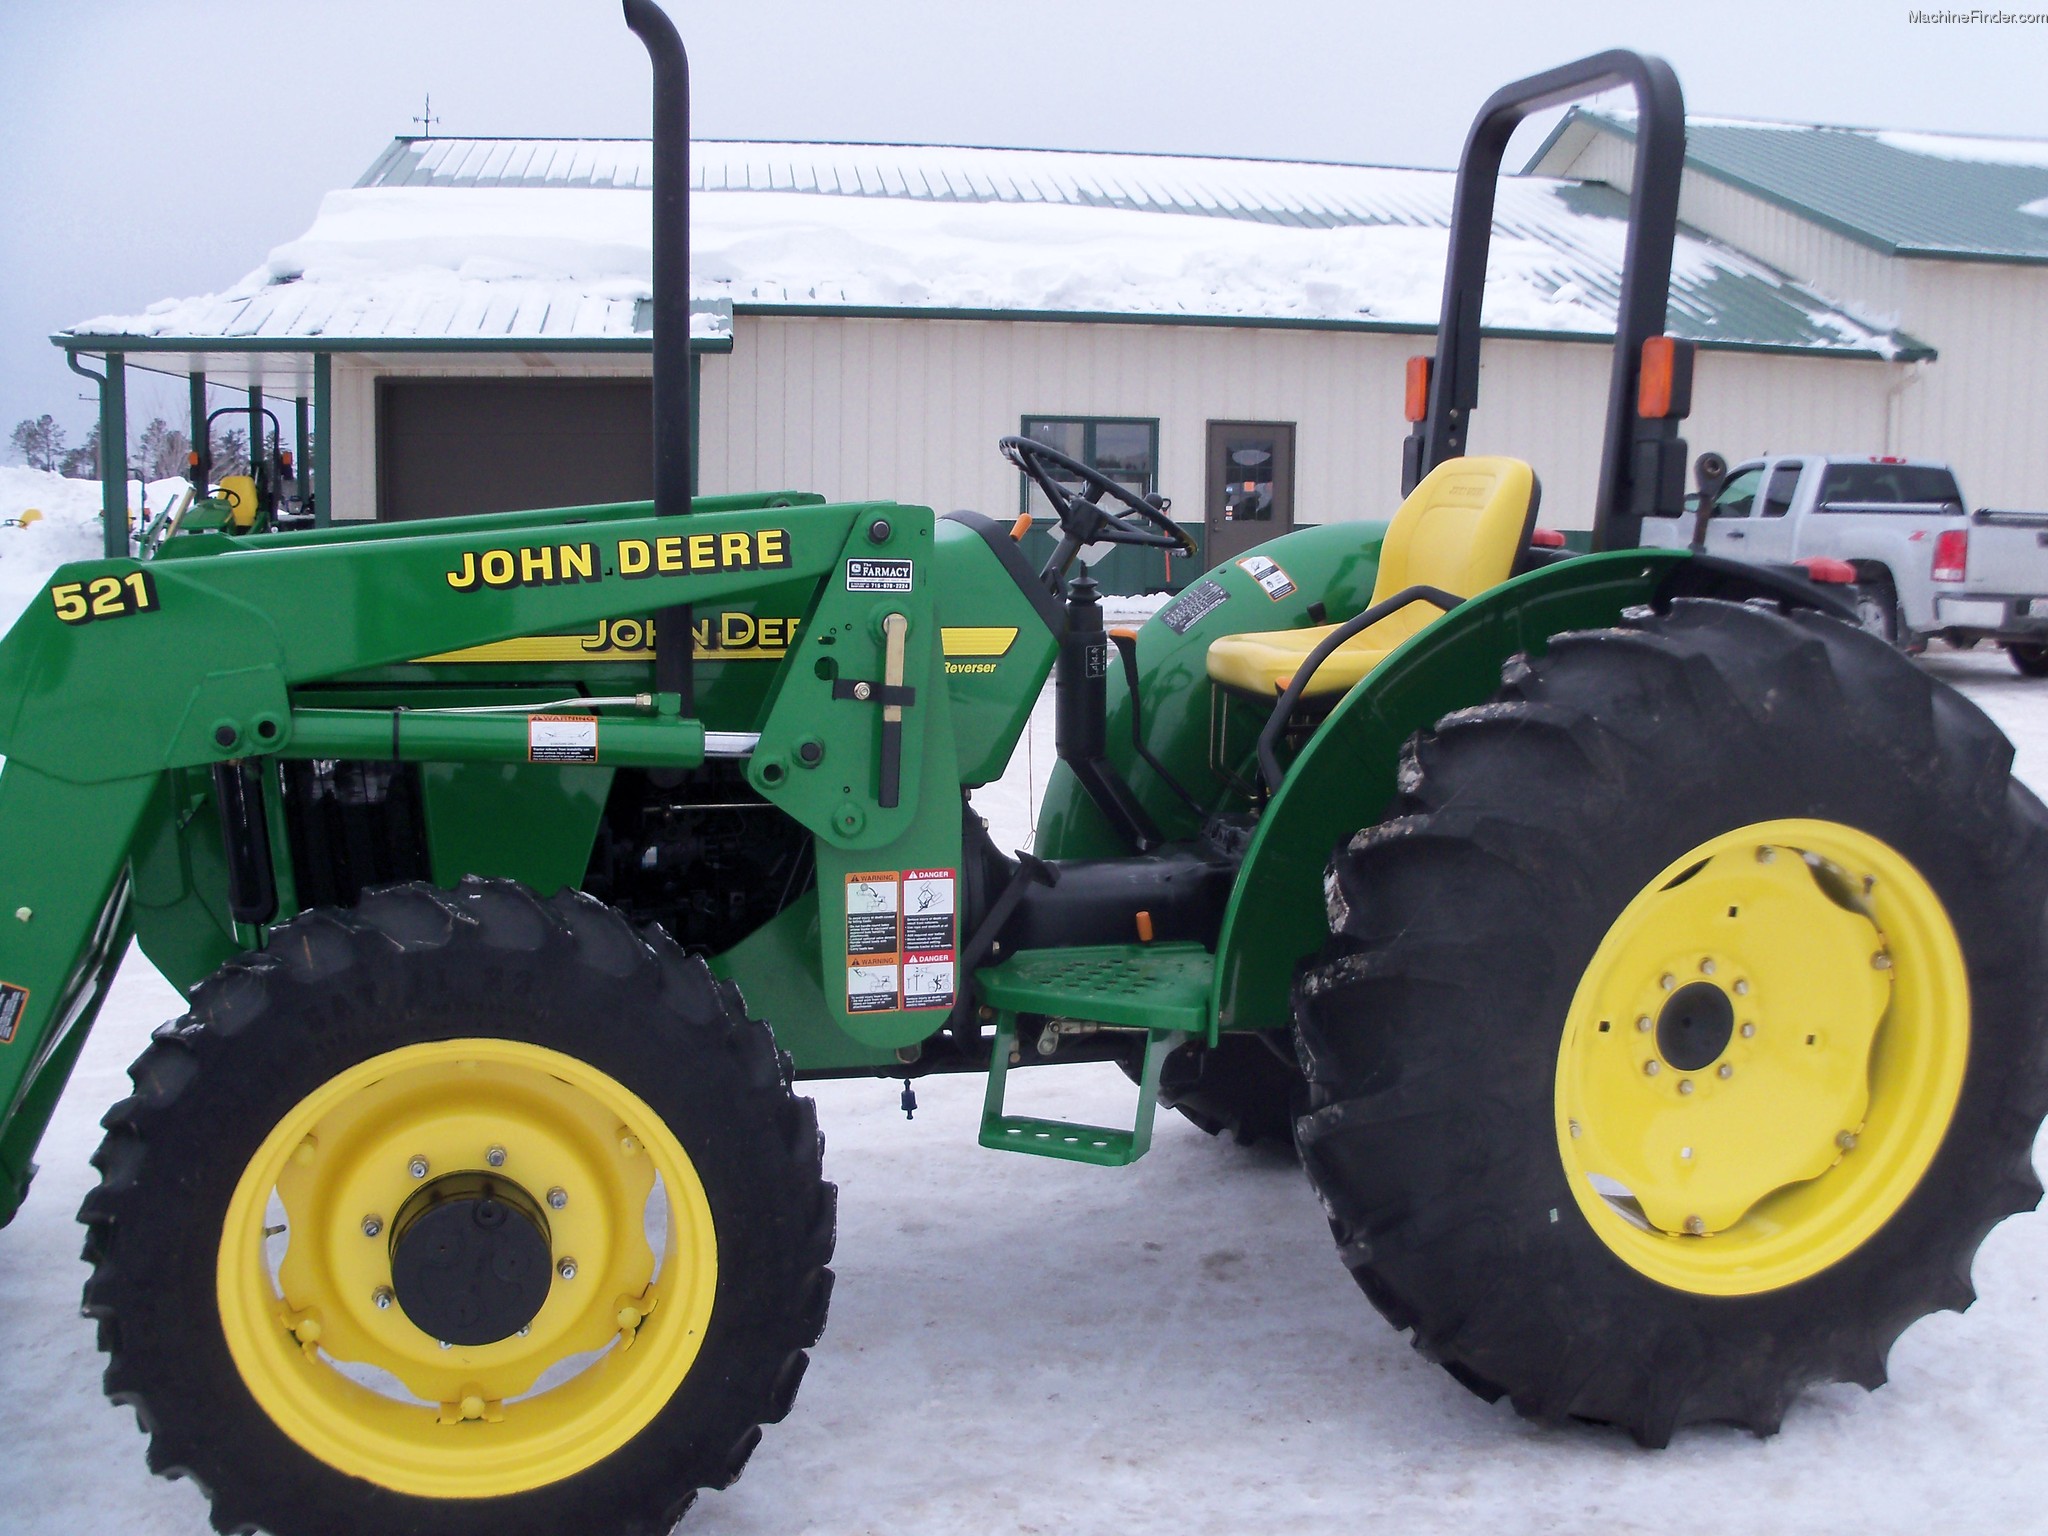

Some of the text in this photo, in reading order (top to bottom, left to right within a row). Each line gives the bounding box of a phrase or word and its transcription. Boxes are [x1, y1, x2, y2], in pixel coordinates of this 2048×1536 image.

[446, 528, 793, 593] JOHN DEERE
[863, 567, 909, 577] FARMACY
[51, 570, 160, 626] 521
[918, 870, 949, 878] DANGER
[861, 957, 894, 965] WARNING
[918, 954, 949, 963] DANGER
